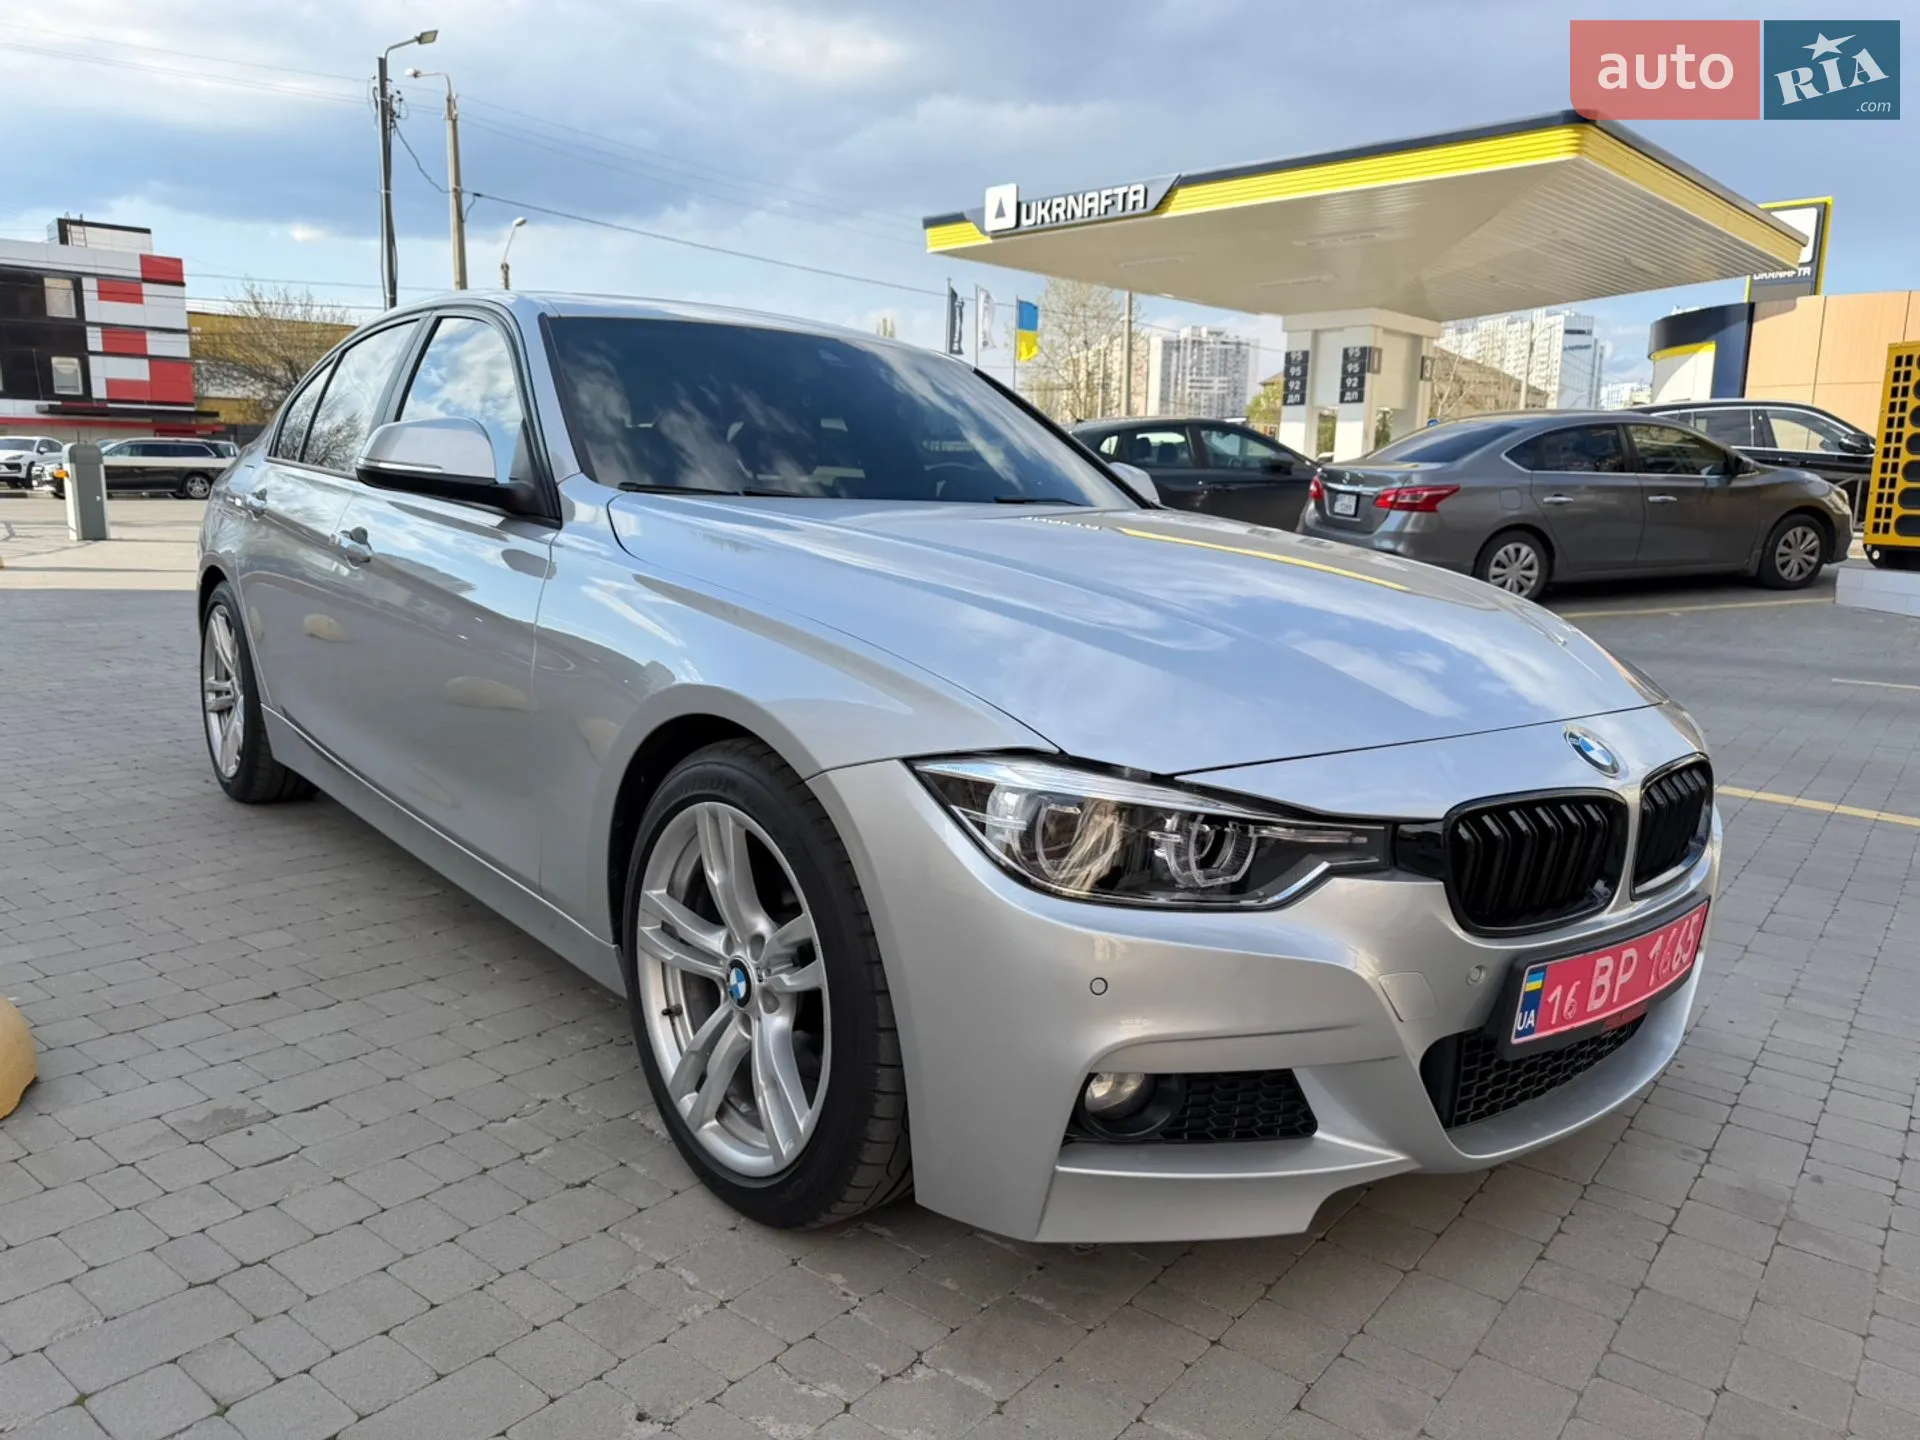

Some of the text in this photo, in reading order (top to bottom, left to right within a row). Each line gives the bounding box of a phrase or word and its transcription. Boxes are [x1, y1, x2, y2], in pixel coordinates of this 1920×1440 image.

[1020, 183, 1146, 226] UKRNAFTA
[1289, 366, 1302, 377] 95
[1347, 363, 1360, 373] 95
[1288, 380, 1301, 391] 92
[1346, 377, 1359, 388] 92
[1547, 981, 1581, 1025] 16
[1648, 913, 1700, 986] 1665
[1517, 1009, 1536, 1031] UA
